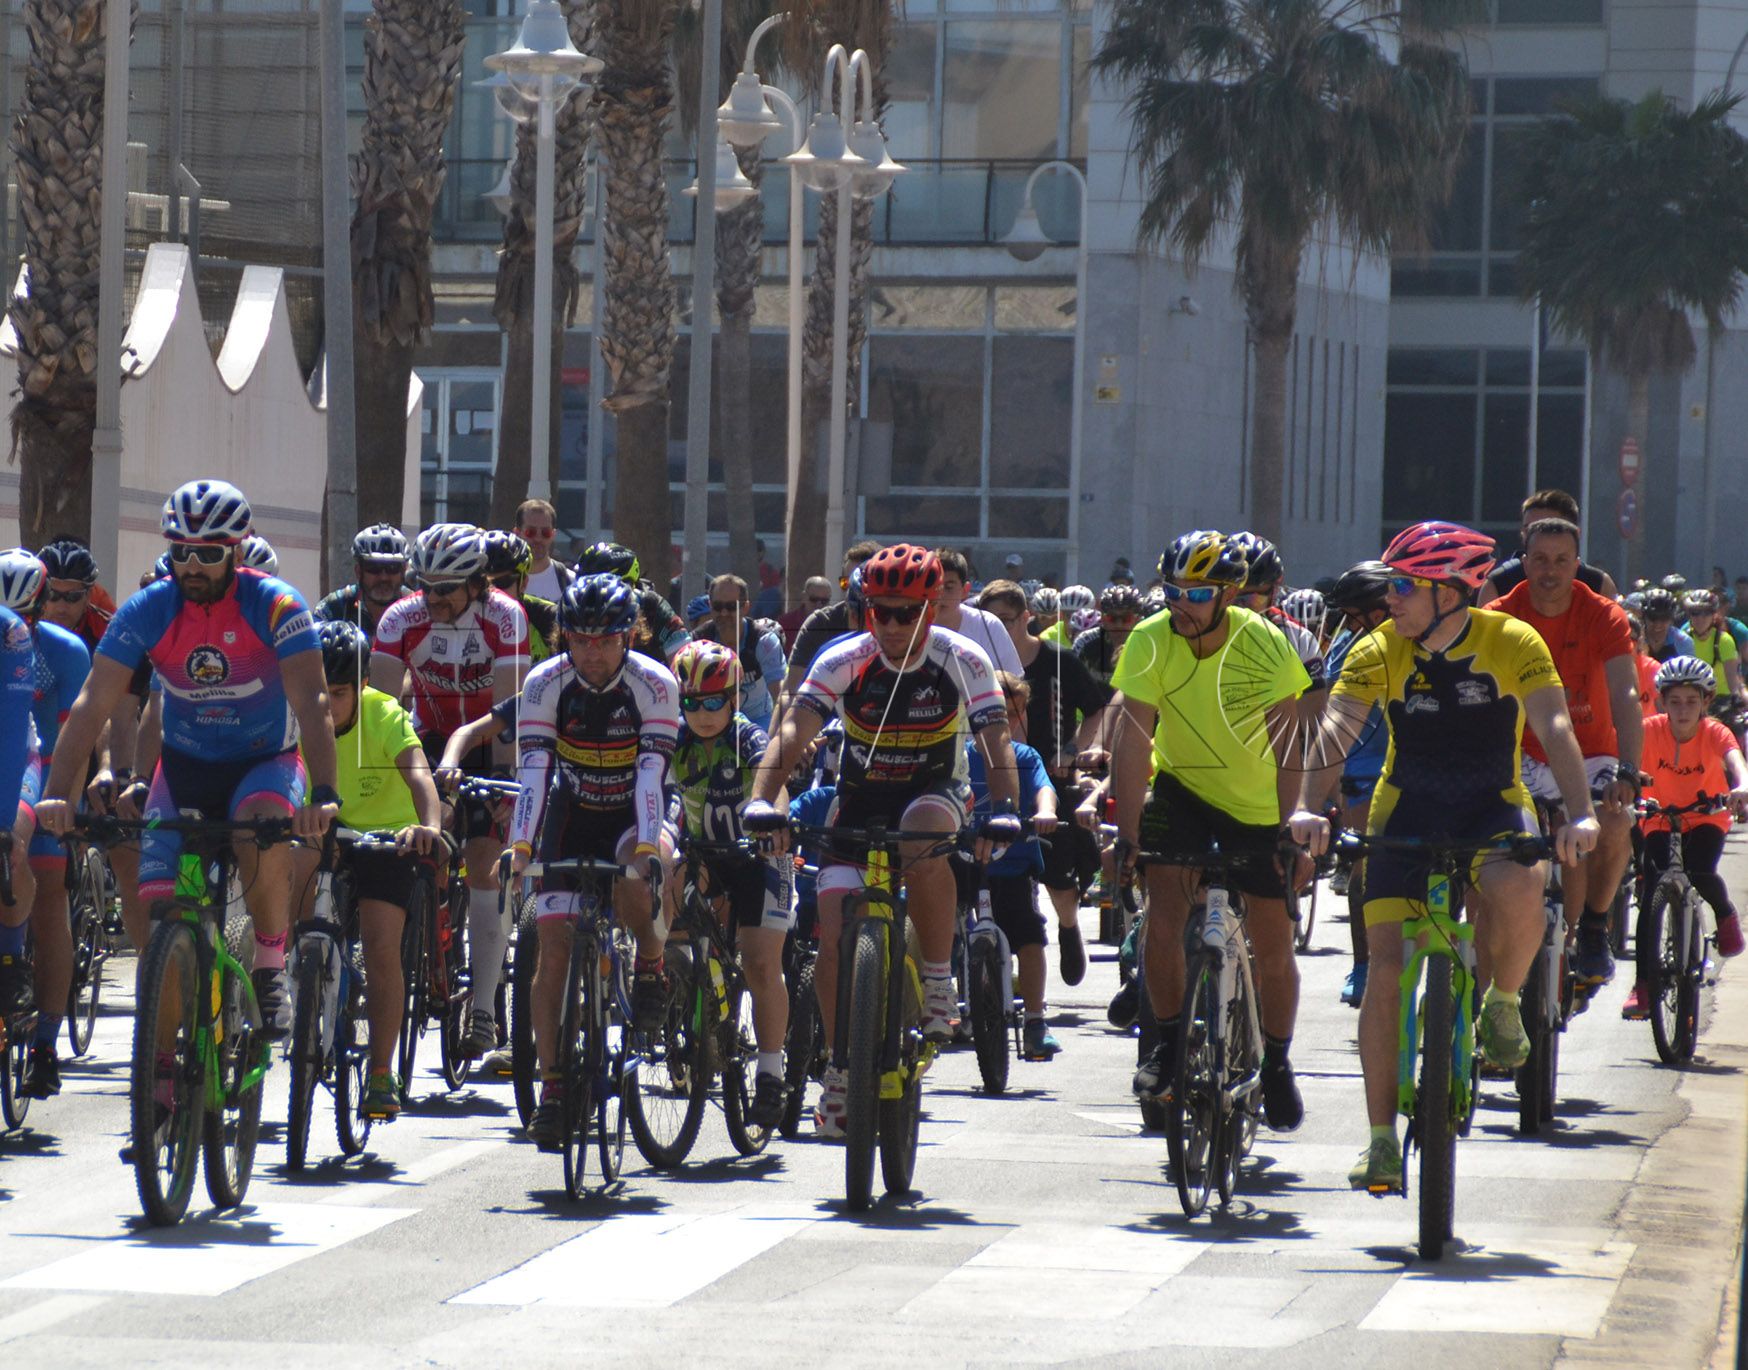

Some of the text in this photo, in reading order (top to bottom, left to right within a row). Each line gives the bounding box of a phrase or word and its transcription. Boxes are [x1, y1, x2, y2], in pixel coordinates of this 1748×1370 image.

[908, 706, 943, 718] MELILLA
[874, 753, 928, 764] MUSCLE
[582, 771, 634, 784] MUSCLE
